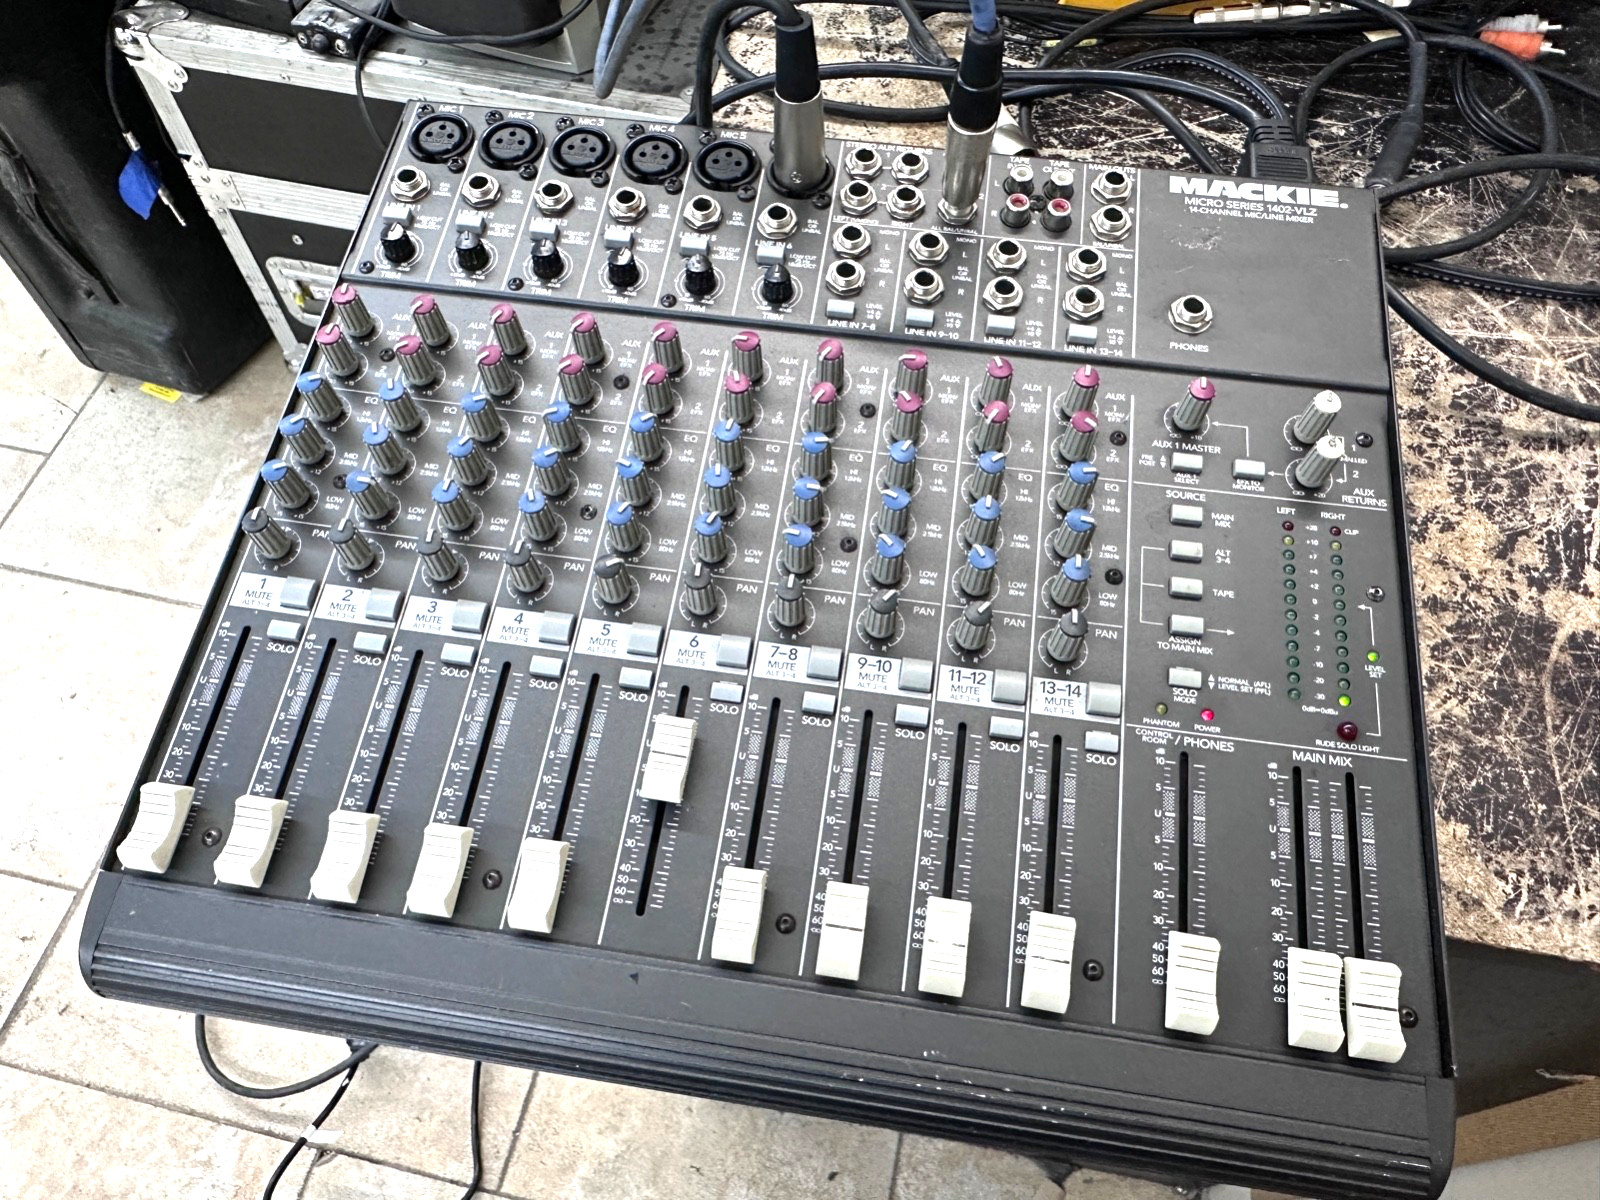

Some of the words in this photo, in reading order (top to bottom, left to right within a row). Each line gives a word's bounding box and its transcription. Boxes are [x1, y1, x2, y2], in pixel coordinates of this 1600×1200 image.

[439, 105, 454, 113] MIC
[508, 111, 525, 119] MIC
[526, 112, 535, 120] 2
[578, 117, 594, 126] MIC
[595, 118, 605, 126] 3
[649, 124, 666, 132] MIC
[667, 125, 676, 133] 4
[721, 131, 737, 139] MIC
[1010, 156, 1030, 165] TAPE
[1049, 159, 1070, 168] TAPE
[1185, 196, 1223, 208] MICRO
[1226, 200, 1264, 211] SERIES
[1267, 204, 1317, 216] 1402-VLZ
[1189, 206, 1242, 218] 14-CHANNEL
[1244, 211, 1284, 221] MIC/LINE
[1286, 215, 1314, 223] MIXER
[468, 321, 487, 330] AUX
[828, 320, 847, 328] LINE
[849, 321, 859, 329] IN
[544, 331, 564, 340] AUX
[905, 328, 925, 336] LINE
[621, 339, 641, 348] AUX
[984, 337, 1005, 345] LINE
[1006, 338, 1016, 346] IN
[1064, 344, 1085, 352] LINE
[1086, 346, 1097, 354] IN
[1169, 342, 1209, 352] PHONES
[700, 348, 720, 357] AUX
[779, 357, 799, 365] AUX
[859, 365, 879, 374] AUX
[940, 374, 960, 383] AUX
[1022, 383, 1042, 392] AUX
[364, 396, 379, 405] EQ
[1105, 392, 1126, 401] AUX
[443, 406, 458, 415] EQ
[522, 415, 537, 424] EQ
[603, 425, 618, 434] EQ
[683, 434, 698, 443] EQ
[766, 444, 781, 453] EQ
[1151, 440, 1172, 449] AUX
[1182, 443, 1221, 454] MASTER
[849, 454, 864, 463] EQ
[933, 463, 948, 473] EQ
[1017, 473, 1033, 482] EQ
[1104, 483, 1119, 492] EQ
[1232, 483, 1265, 492] MONITOR
[1353, 488, 1374, 497] AUX
[1166, 490, 1206, 501] SOURCE
[1342, 495, 1387, 507] RETURNS
[1277, 507, 1296, 516] LEFT
[1321, 512, 1346, 521] RIGHT
[1211, 512, 1234, 522] MAIN
[1215, 520, 1231, 528] MIX
[1344, 528, 1359, 536] CLIP
[395, 540, 416, 550] PAN
[479, 551, 500, 561] PAN
[1215, 549, 1231, 557] ALT
[563, 562, 585, 572] PAN
[649, 572, 671, 583] PAN
[260, 578, 267, 589] 1
[735, 583, 758, 594] PAN
[245, 590, 272, 600] MUTE
[342, 590, 353, 601] 2
[1213, 589, 1235, 599] TAPE
[824, 594, 846, 605] PAN
[330, 602, 357, 612] MUTE
[427, 601, 438, 613] 3
[913, 606, 935, 616] PAN
[415, 614, 443, 624] MUTE
[514, 613, 524, 624] 4
[1003, 617, 1025, 628] PAN
[502, 625, 530, 636] MUTE
[601, 624, 611, 636] 5
[1095, 629, 1118, 640] PAN
[589, 637, 618, 647] MUTE
[689, 635, 699, 647] 6
[1168, 636, 1201, 646] ASSIGN
[266, 642, 295, 653] SOLO
[1157, 641, 1169, 650] TO
[1171, 643, 1195, 653] MAIN
[1197, 646, 1213, 655] MIX
[678, 649, 706, 659] MUTE
[353, 655, 382, 666] SOLO
[768, 660, 796, 671] MUTE
[440, 667, 469, 678] SOLO
[1365, 665, 1386, 674] LEVEL
[858, 673, 887, 683] MUTE
[1218, 676, 1249, 686] NORMAL
[1254, 680, 1271, 689] (AFL)
[529, 679, 558, 690] SOLO
[1218, 684, 1240, 692] LEVEL
[1241, 686, 1253, 694] SET
[950, 685, 980, 695] MUTE
[1172, 688, 1197, 697] SOLO
[618, 690, 648, 702] SOLO
[1174, 696, 1197, 705] MODE
[1044, 697, 1074, 708] MUTE
[710, 703, 739, 715] SOLO
[802, 715, 831, 727] SOLO
[1143, 717, 1180, 728] PHANTOM
[1135, 728, 1174, 739] CONTROL
[1194, 724, 1221, 733] POWER
[895, 729, 925, 740] SOLO
[1142, 736, 1167, 745] ROOM
[1184, 736, 1235, 752] PHONES
[989, 741, 1020, 753] SOLO
[1315, 739, 1335, 749] RUDE
[1336, 742, 1357, 751] SOLO
[1358, 744, 1380, 754] LIGHT
[1086, 753, 1117, 766] SOLO
[1293, 751, 1326, 765] MAIN
[1329, 755, 1353, 768] MIX
[1268, 772, 1278, 780] 10
[1271, 879, 1281, 887] 10
[1271, 907, 1283, 916] 20
[1272, 934, 1284, 942] 30
[1273, 960, 1285, 969] 40
[1273, 972, 1286, 981] 50
[1273, 985, 1286, 994] 60
